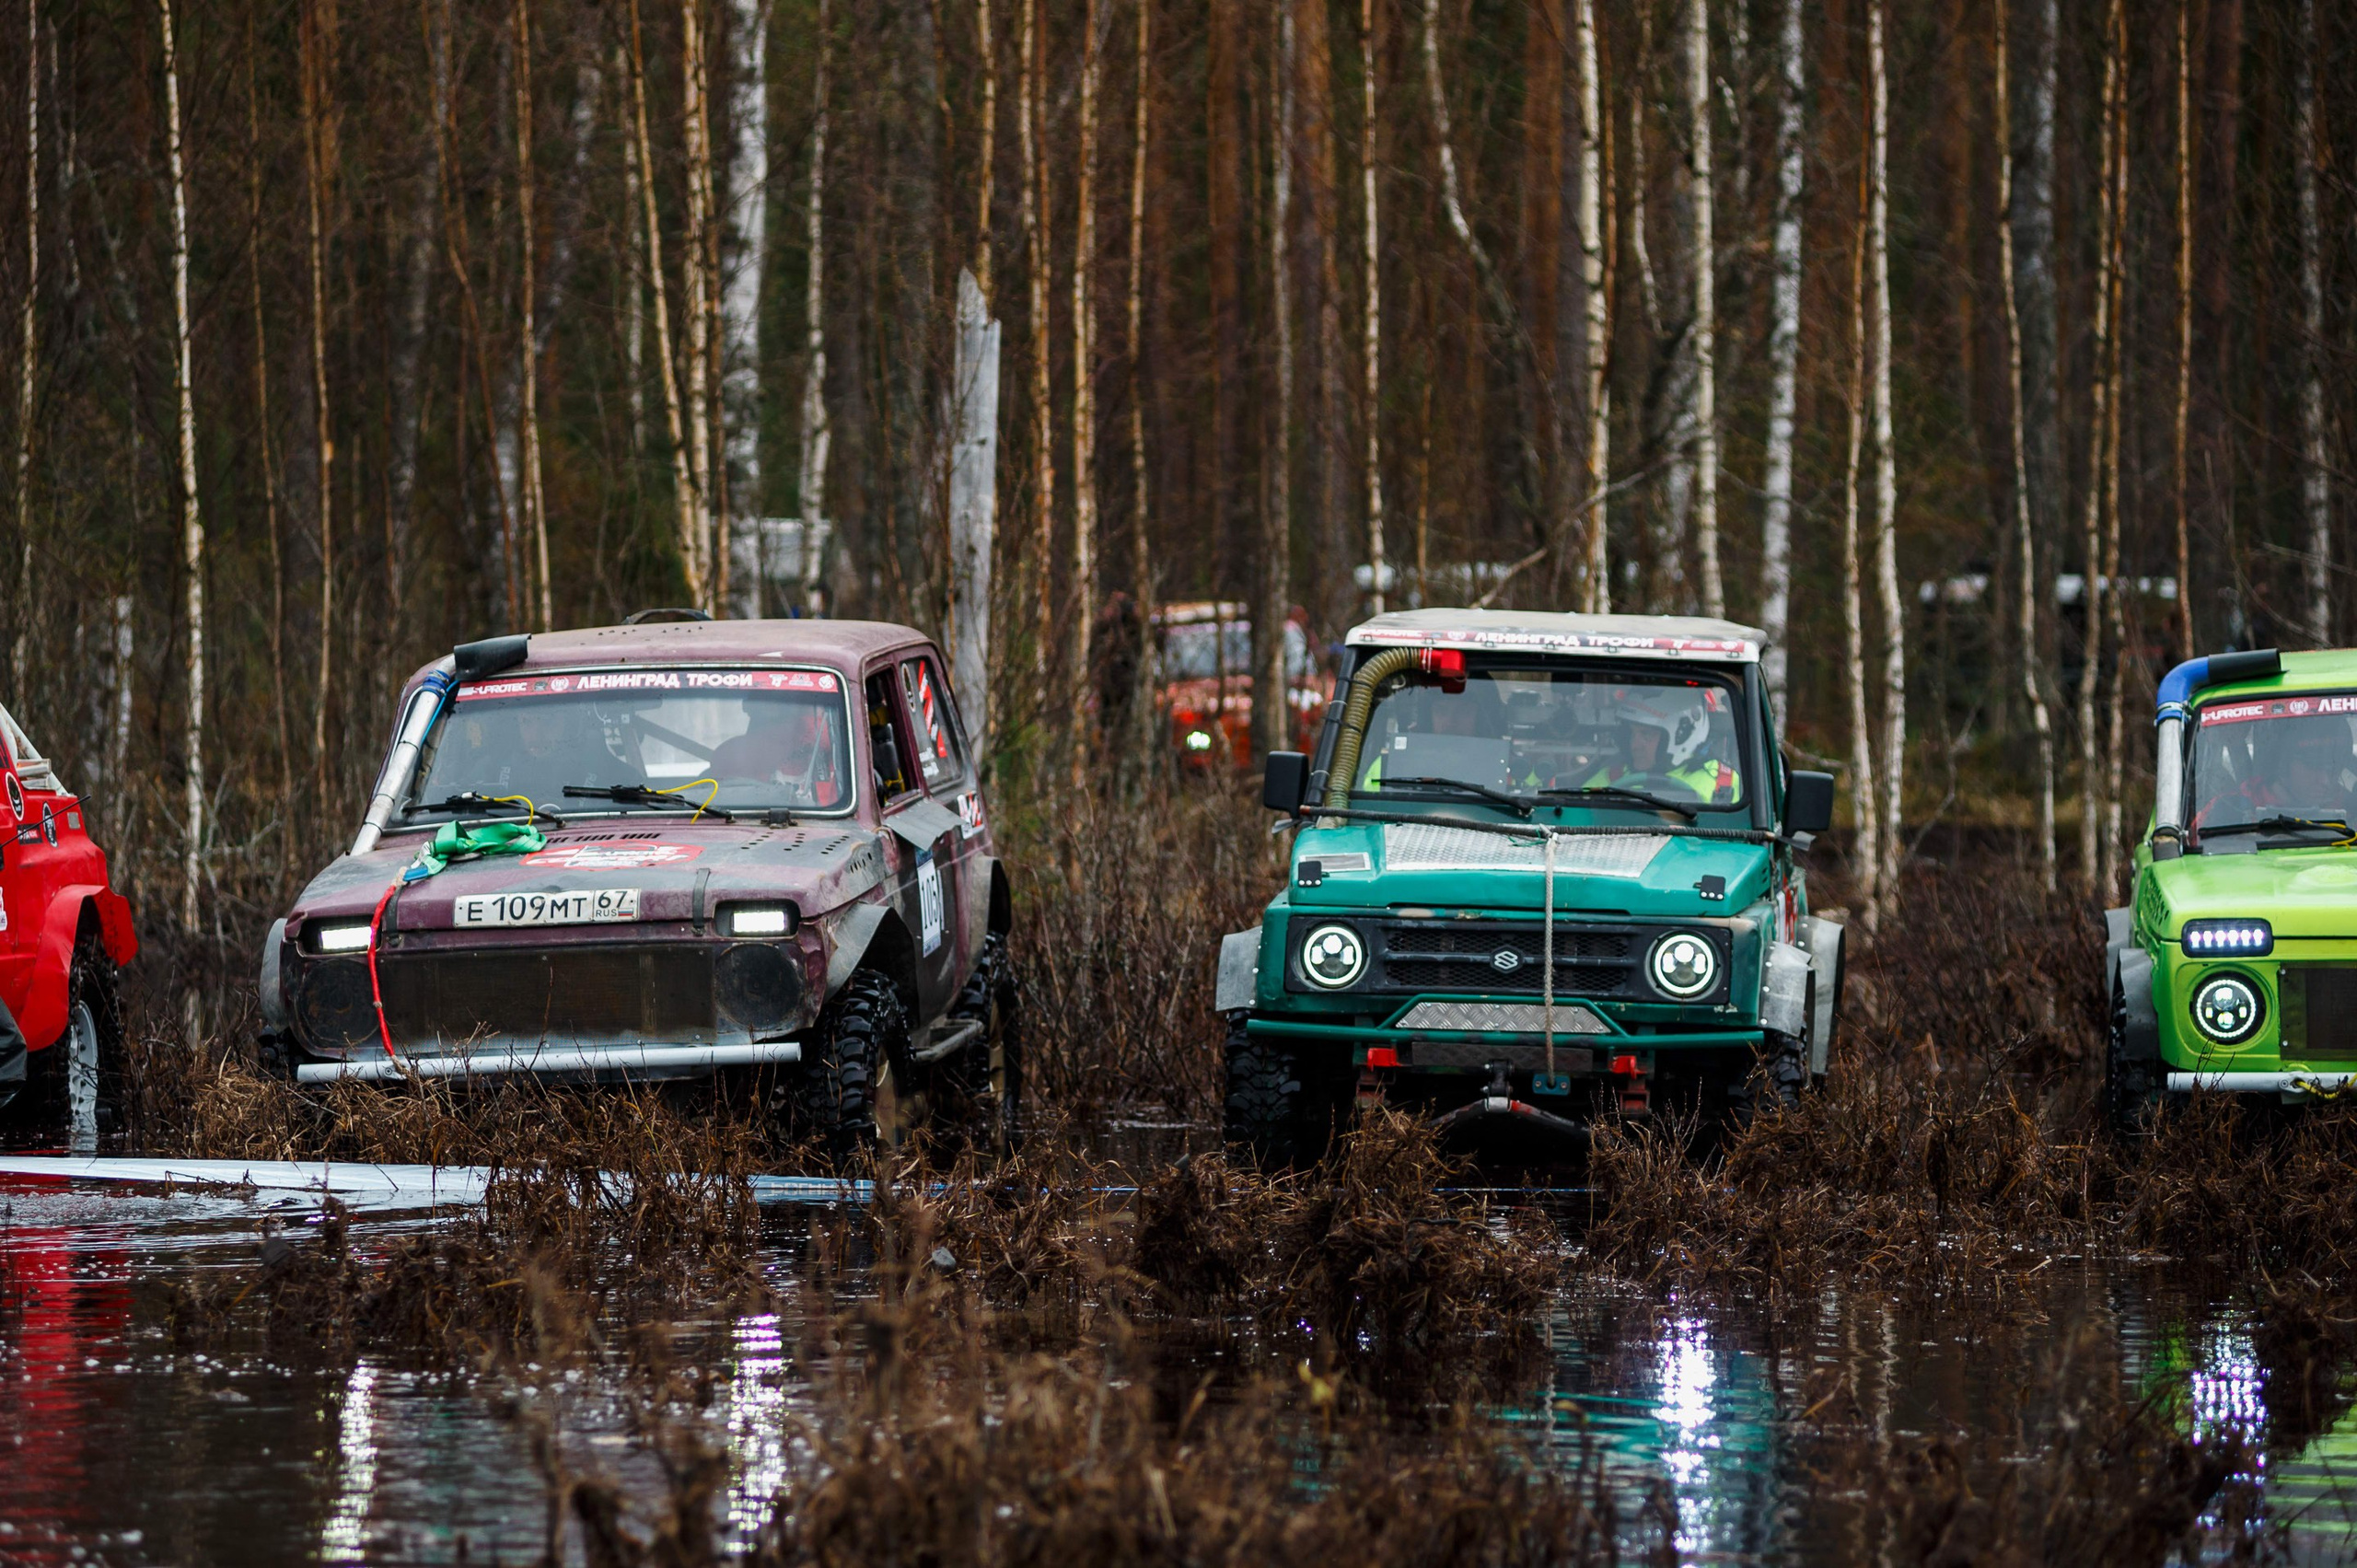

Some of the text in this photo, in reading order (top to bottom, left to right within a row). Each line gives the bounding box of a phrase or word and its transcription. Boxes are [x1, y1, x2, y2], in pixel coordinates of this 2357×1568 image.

[1475, 632, 1655, 648] ЛЕНИНГРАД ТРОФИ
[577, 673, 680, 689] ЛЕНИНГРАД
[687, 673, 753, 687] ТРОФИ
[2318, 698, 2357, 713] ЛЕН
[598, 890, 628, 909] 67
[596, 909, 617, 918] RUS
